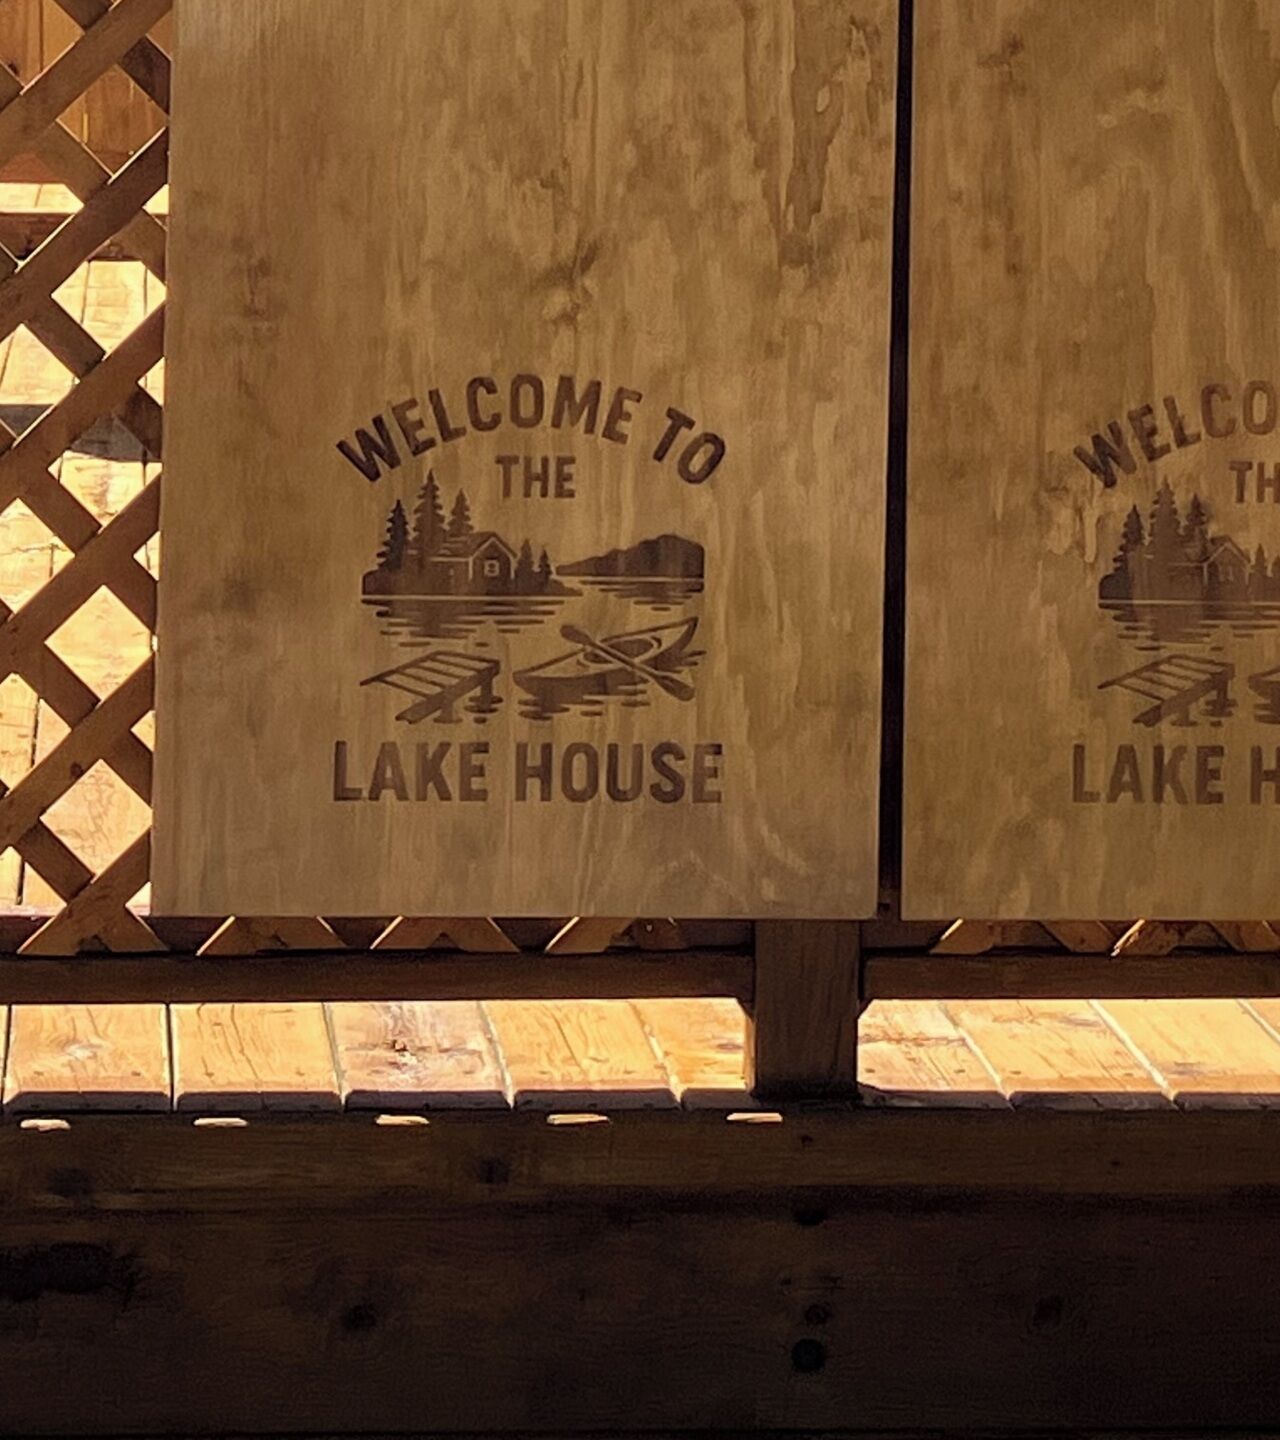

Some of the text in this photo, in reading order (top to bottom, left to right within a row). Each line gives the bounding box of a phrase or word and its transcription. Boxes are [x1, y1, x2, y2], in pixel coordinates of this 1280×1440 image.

[336, 373, 726, 485] WELCOME TO
[495, 455, 576, 499] THE
[332, 740, 723, 804] LAKE HOUSE
[1072, 744, 1225, 805] LAKE
